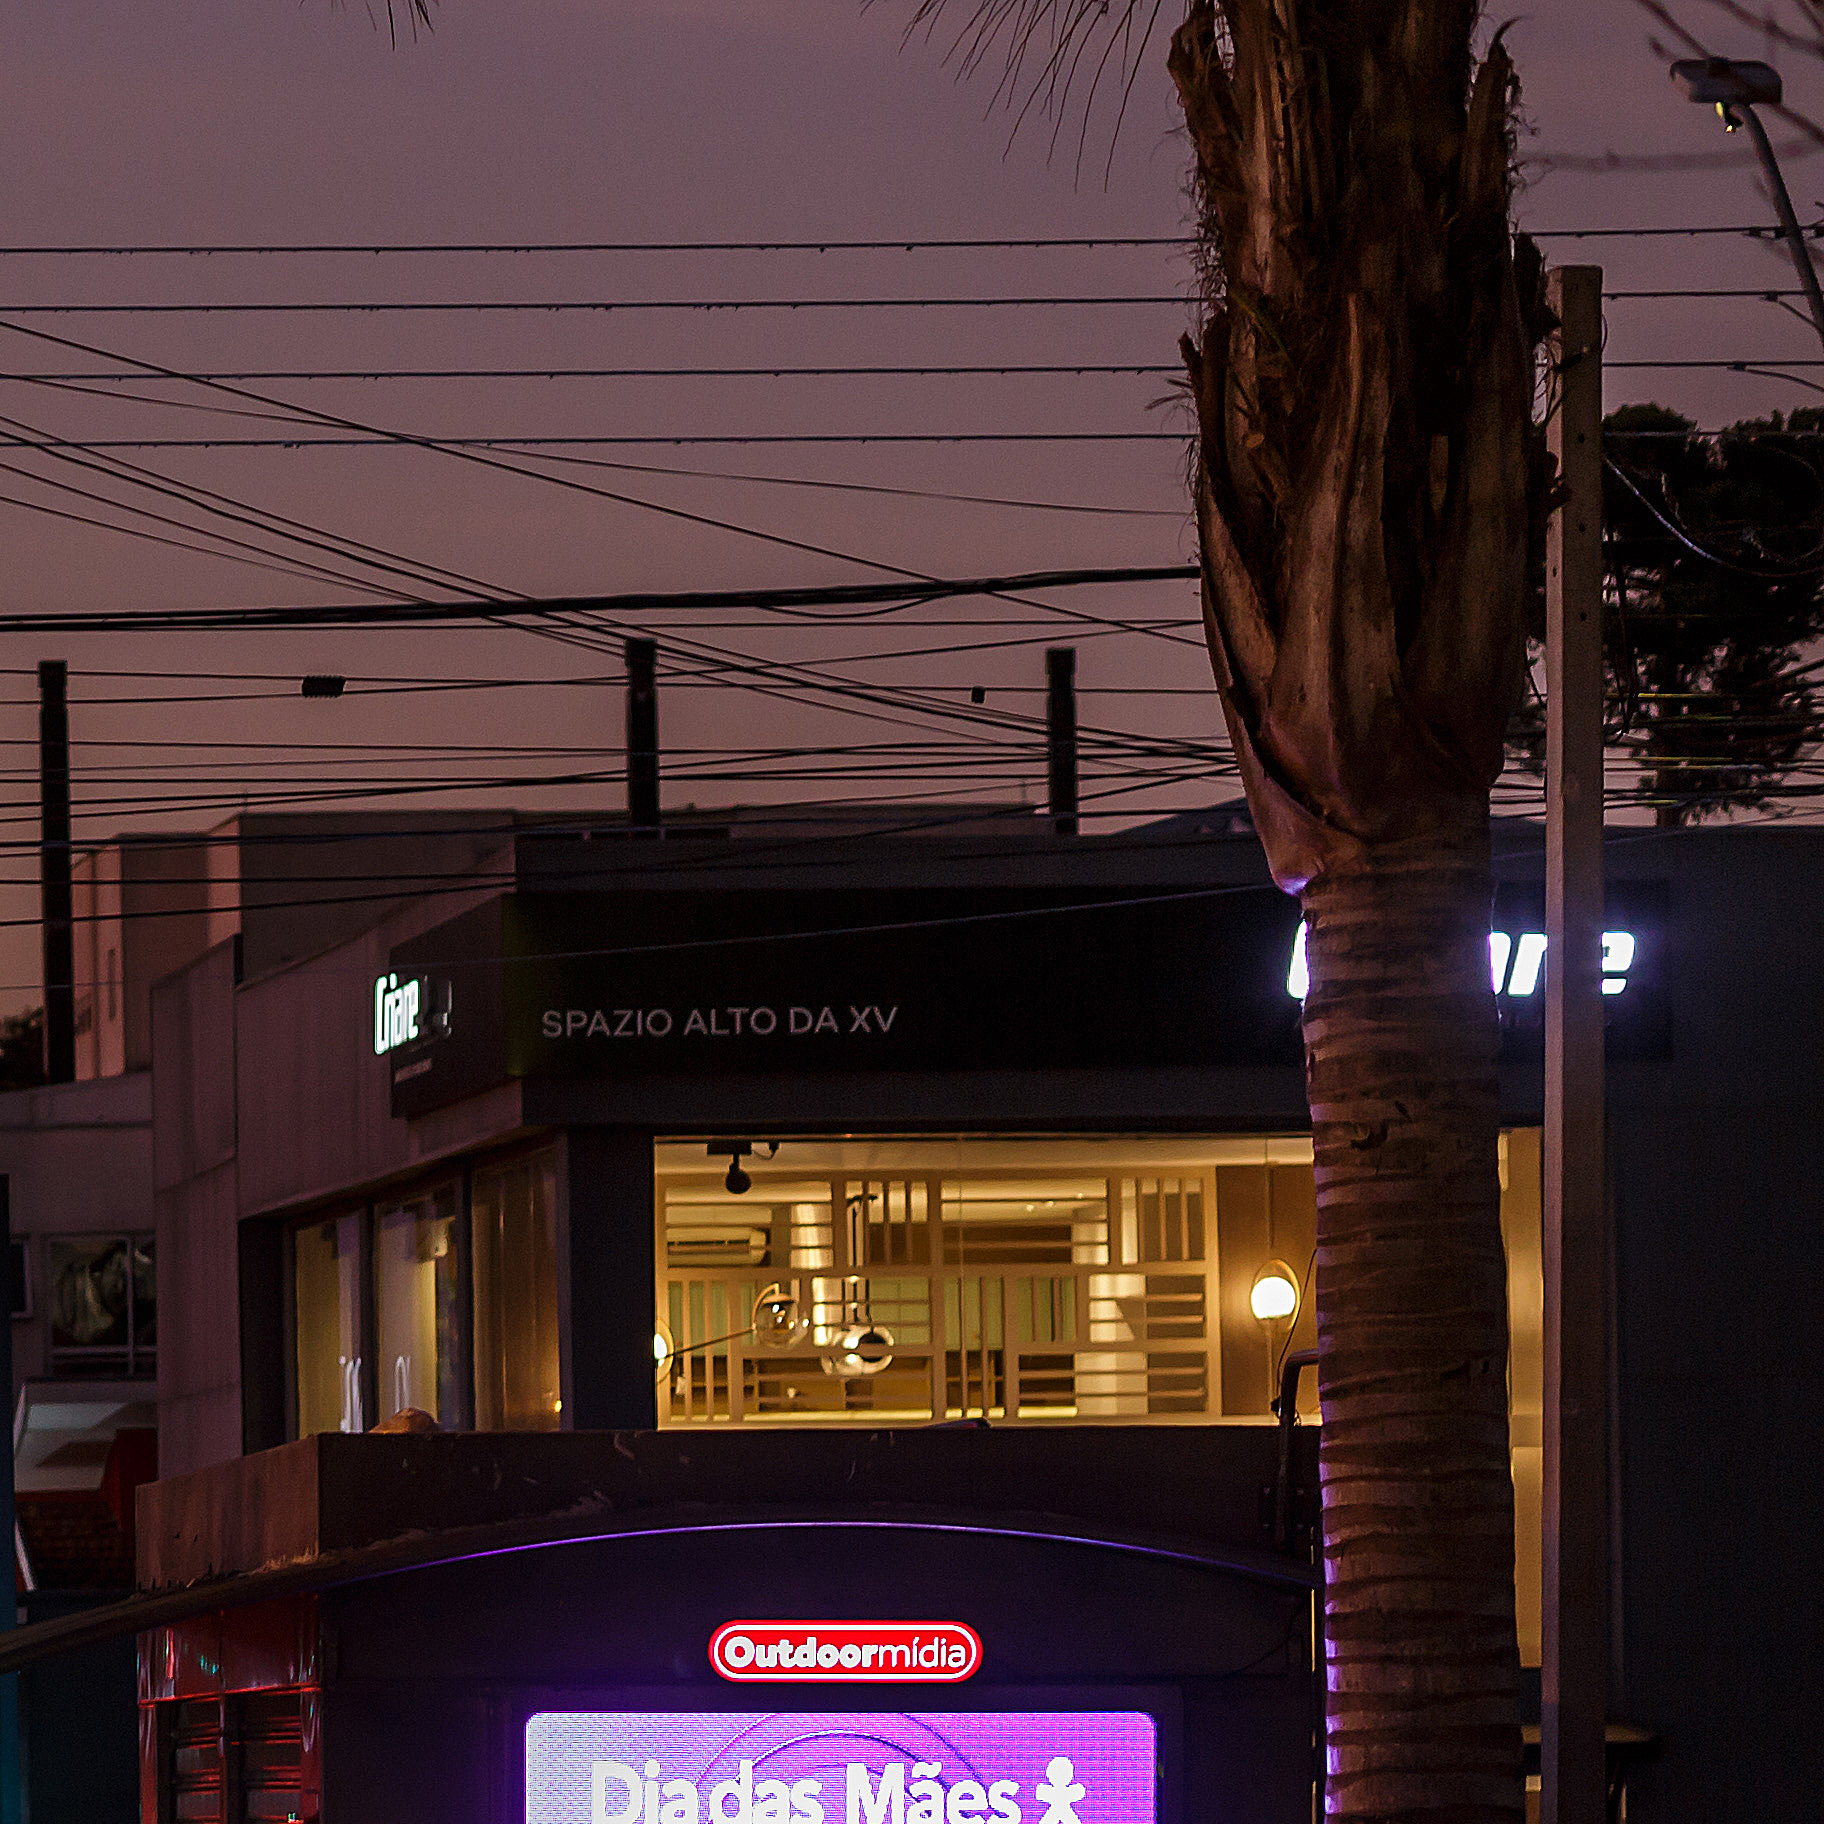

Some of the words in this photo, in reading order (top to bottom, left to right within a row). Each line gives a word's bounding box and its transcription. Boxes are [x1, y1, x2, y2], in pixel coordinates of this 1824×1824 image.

[540, 1008, 673, 1038] SPAZIO
[683, 1007, 777, 1036] ALTO
[789, 1006, 838, 1034] DA
[850, 1006, 899, 1034] XV
[724, 1634, 967, 1670] Outdoormídia
